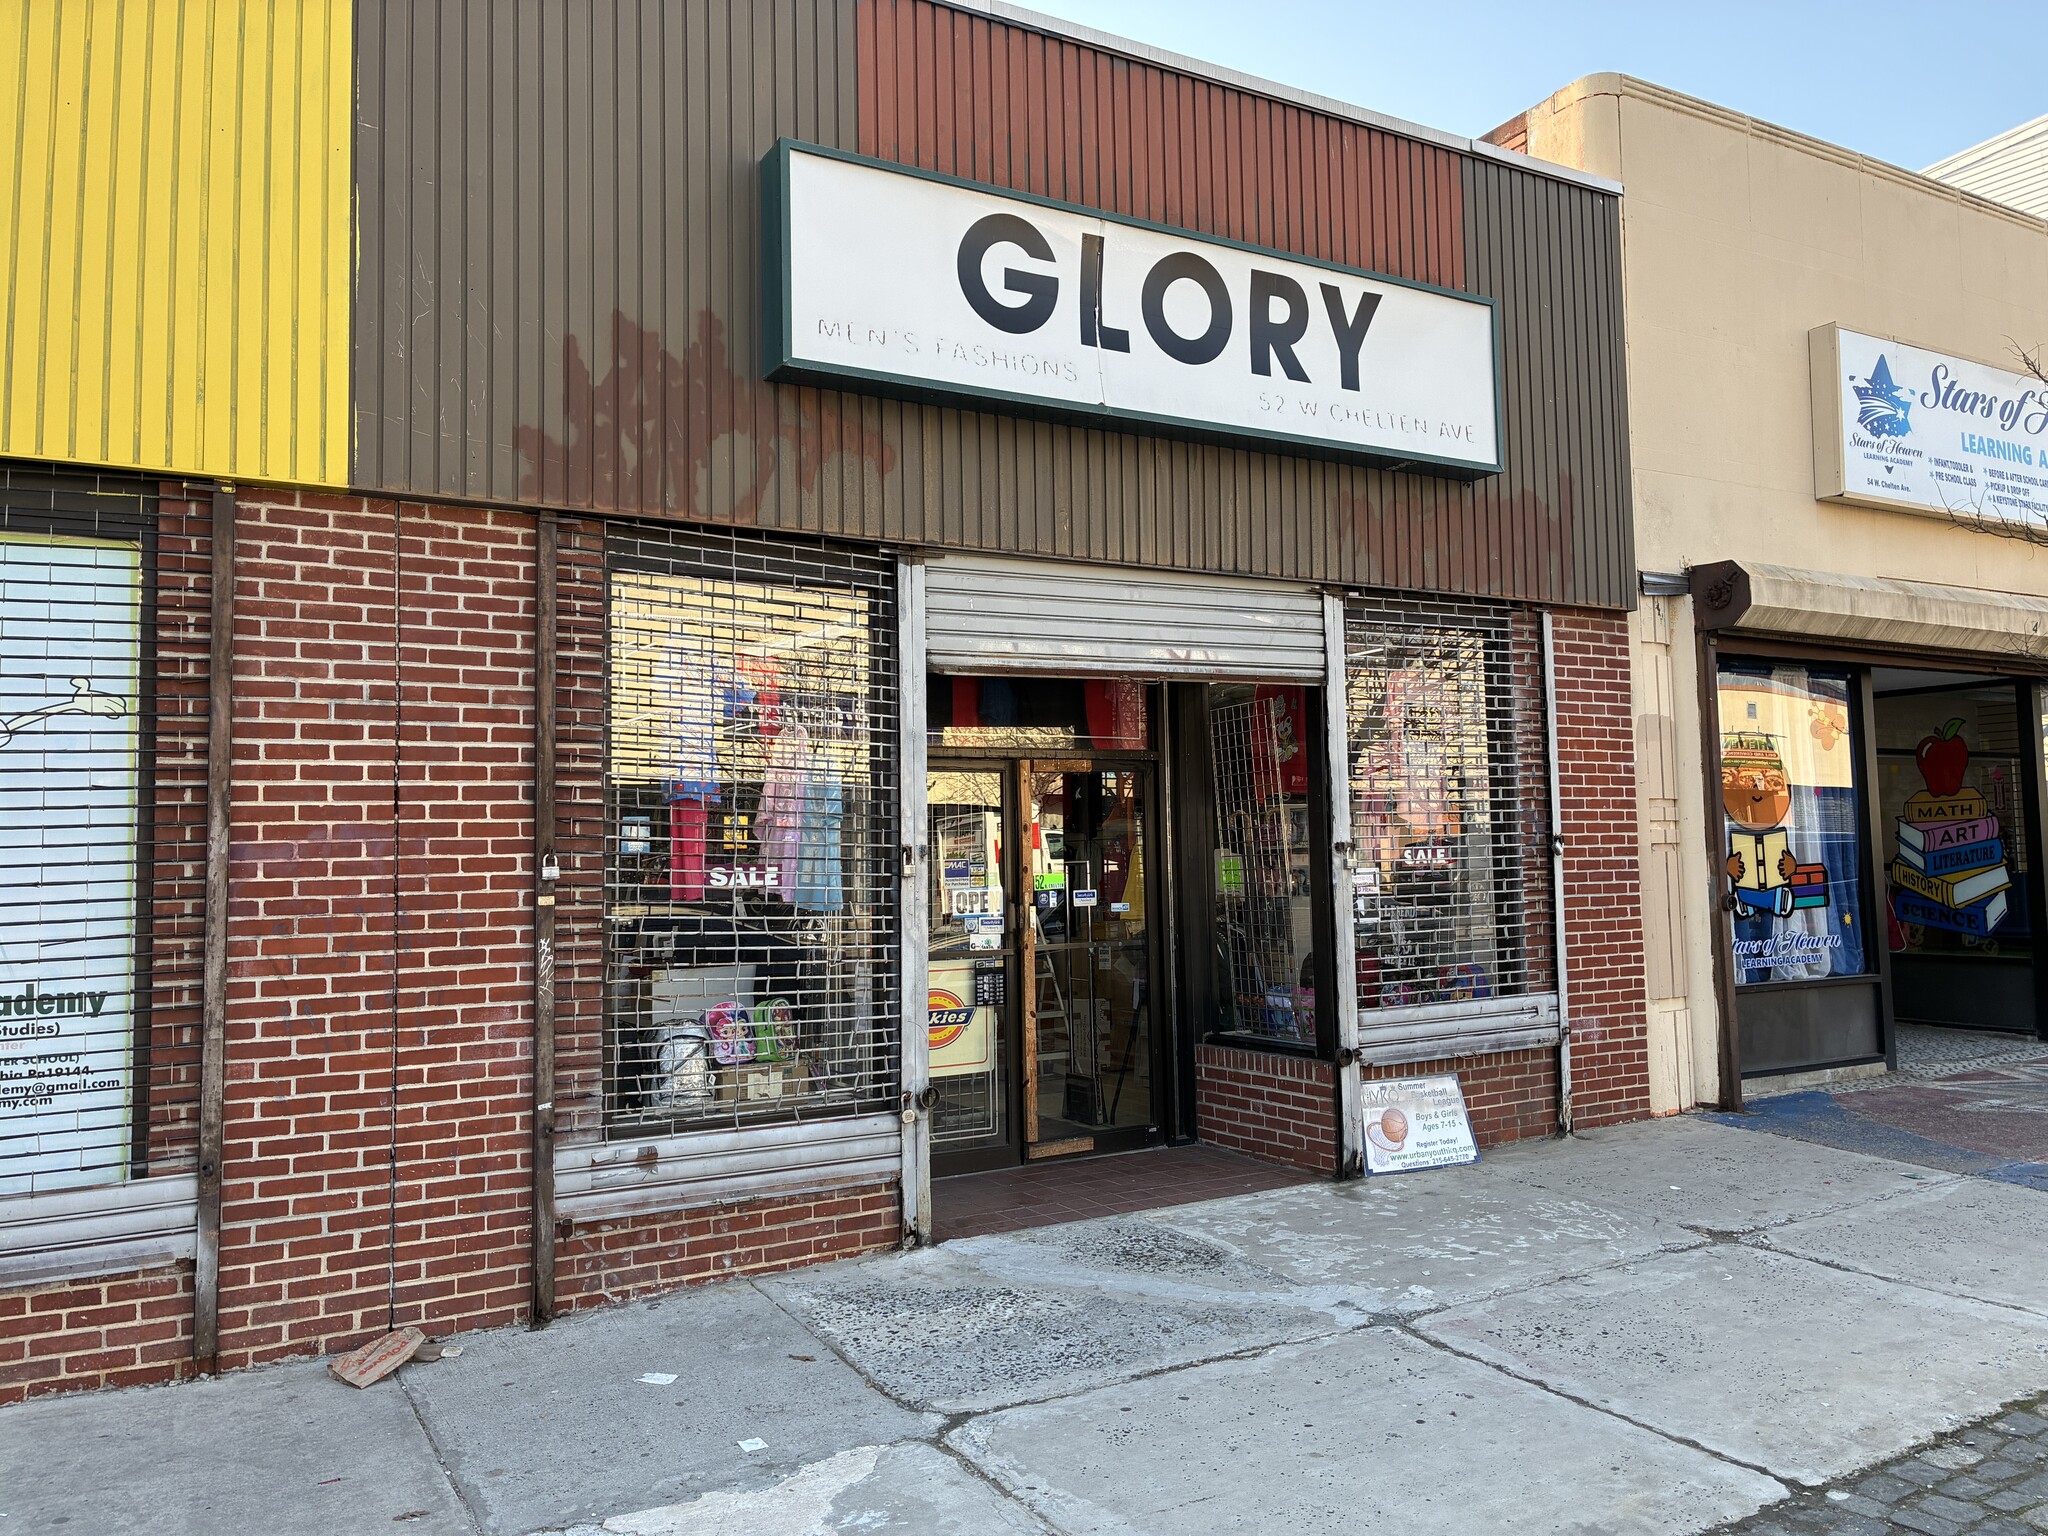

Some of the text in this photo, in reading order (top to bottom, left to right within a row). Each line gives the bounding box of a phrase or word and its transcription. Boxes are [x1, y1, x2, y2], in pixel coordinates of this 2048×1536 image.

[957, 213, 1383, 392] GLORY
[818, 318, 1078, 382] MEN'S FASHIONS
[1920, 363, 1998, 418] Stars
[1999, 390, 2036, 431] of
[1259, 392, 1475, 444] 52 W CHELTEN AVE
[1849, 432, 1923, 458] Stars of Heaven
[1961, 431, 2032, 466] LEARNING
[1863, 452, 1913, 467] LEARNING ACADEMY
[1867, 477, 1873, 485] 54
[1881, 480, 1900, 490] Chelten
[1935, 471, 1977, 487] PRE SCHOOL CLASS
[1918, 804, 1973, 818] MATH
[1939, 824, 1979, 846] ART
[1404, 848, 1446, 865] SALE
[1933, 845, 1995, 871] LITERATURE
[709, 867, 779, 886] SALE
[1035, 874, 1045, 889] 52
[1902, 869, 1940, 898] HISTORY
[1902, 902, 1980, 930] SCIENCE
[1762, 932, 1783, 956] of
[1777, 930, 1841, 955] Heaven
[1742, 953, 1824, 969] LEARNING ACADEMY
[929, 1011, 967, 1024] kies
[0, 1022, 61, 1036] tudies)
[0, 1079, 120, 1096] emy@gmail.com
[1397, 1082, 1426, 1091] Summer
[1411, 1088, 1448, 1099] Basketball
[1433, 1097, 1460, 1107] League
[1416, 1108, 1458, 1121] Boys & Girls
[1422, 1120, 1456, 1132] Ages 7-15
[1416, 1137, 1459, 1149] Register Today!
